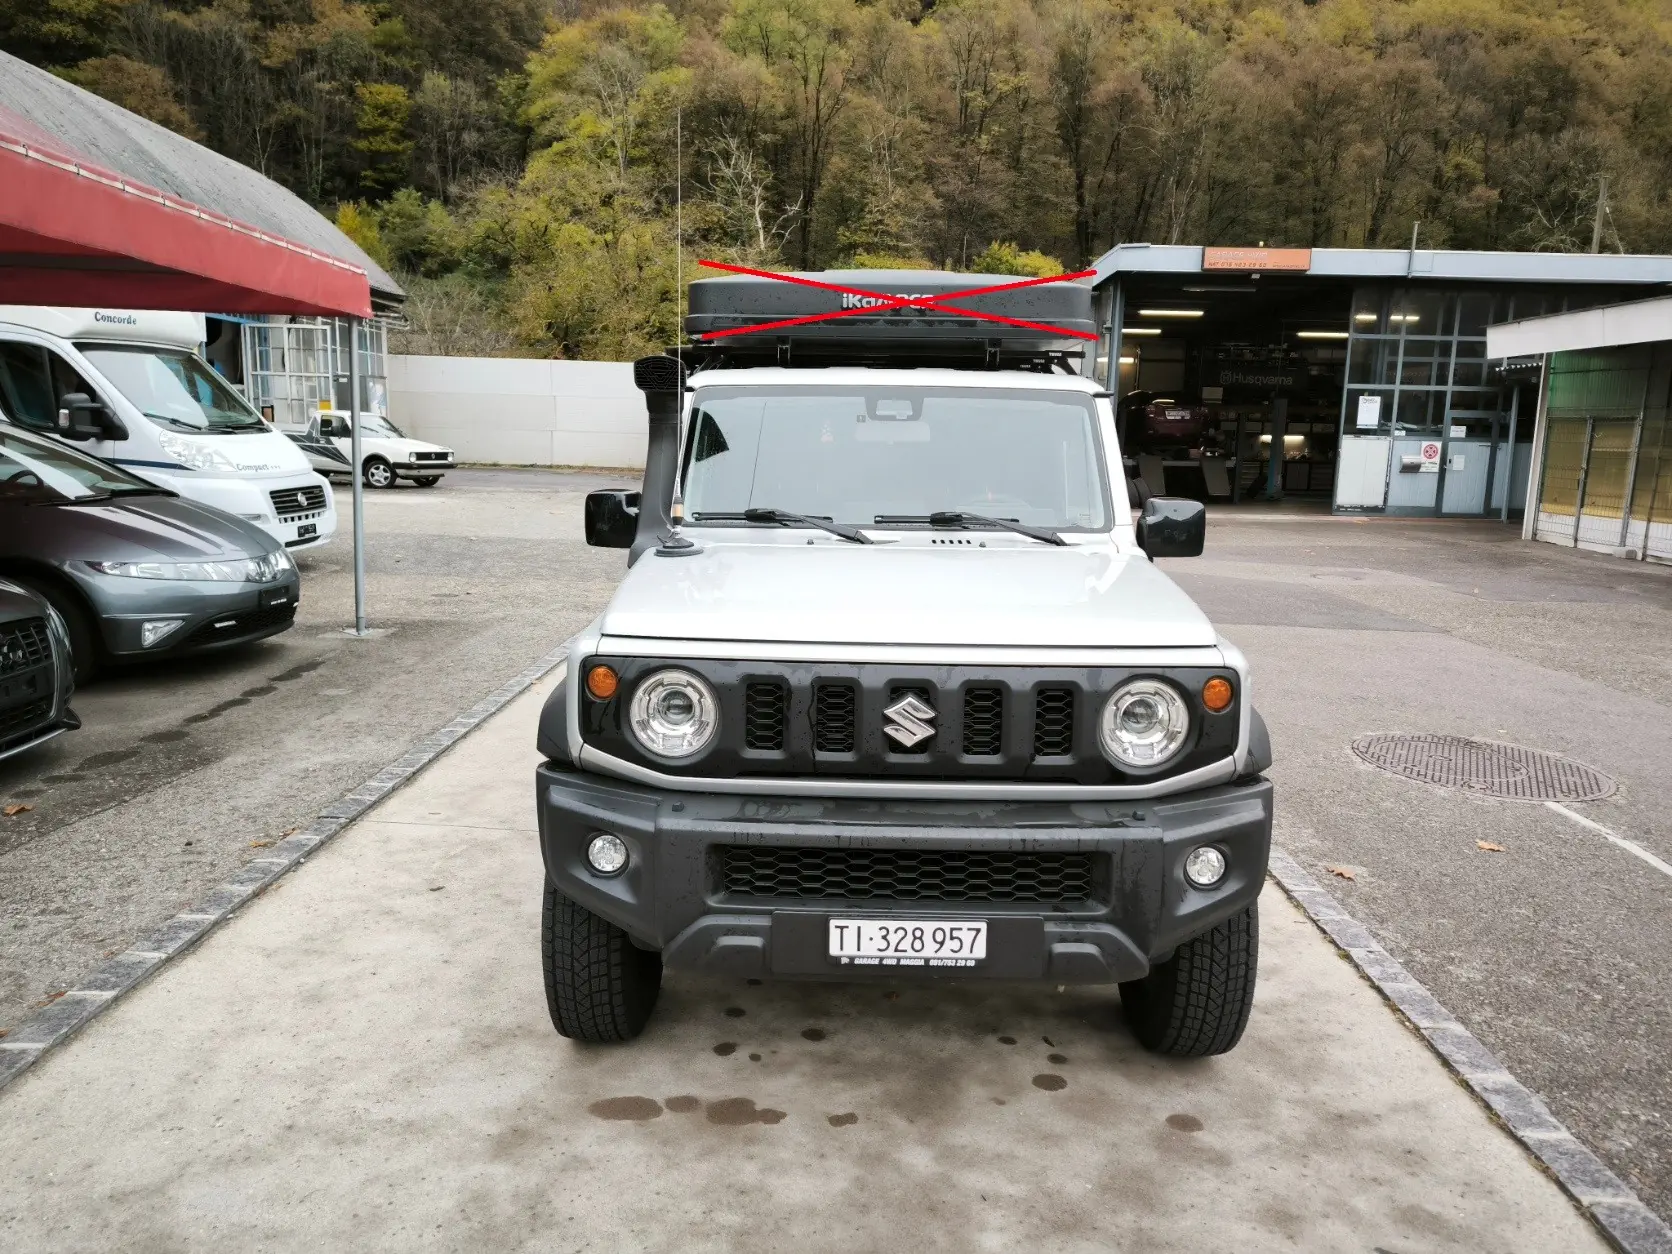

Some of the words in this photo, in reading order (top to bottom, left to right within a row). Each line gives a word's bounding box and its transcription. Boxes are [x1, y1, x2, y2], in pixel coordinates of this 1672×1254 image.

[94, 311, 137, 325] Concorde
[1232, 372, 1293, 386] Husqvarna
[236, 464, 269, 472] Compact
[854, 957, 880, 965] GARAGE
[899, 958, 925, 966] MAGGIA
